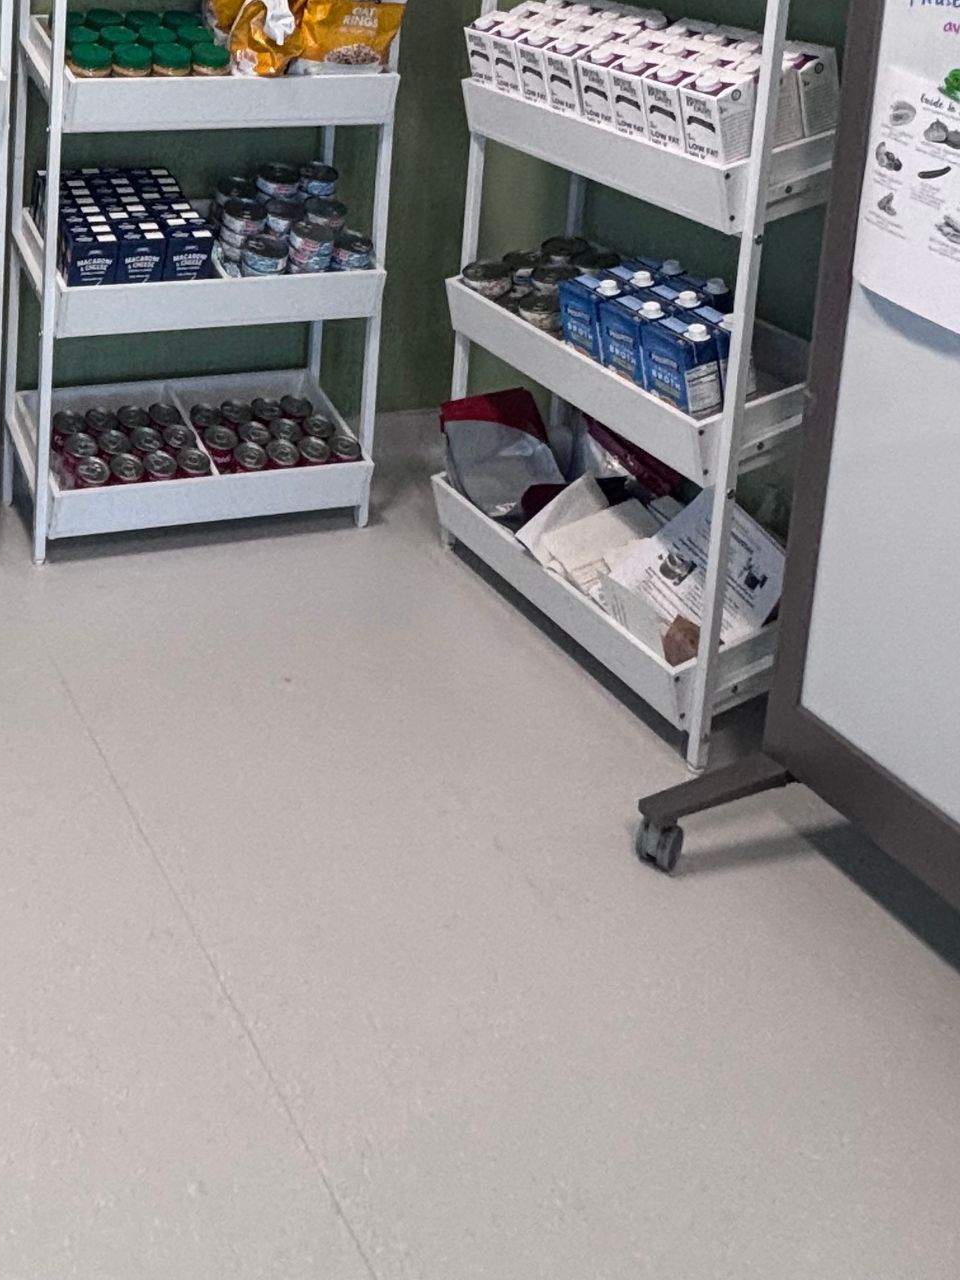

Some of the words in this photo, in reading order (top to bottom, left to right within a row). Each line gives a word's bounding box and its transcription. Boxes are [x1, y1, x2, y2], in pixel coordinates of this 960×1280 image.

[352, 7, 377, 18] OAT
[342, 15, 378, 28] RINGS
[650, 130, 667, 141] LOW
[668, 133, 680, 145] FAT
[688, 142, 705, 153] LOW
[706, 147, 719, 159] FAT
[76, 258, 113, 267] MACARONI
[124, 255, 160, 264] MACARONI
[172, 253, 208, 262] MACARONI
[651, 369, 681, 391] BROTH
